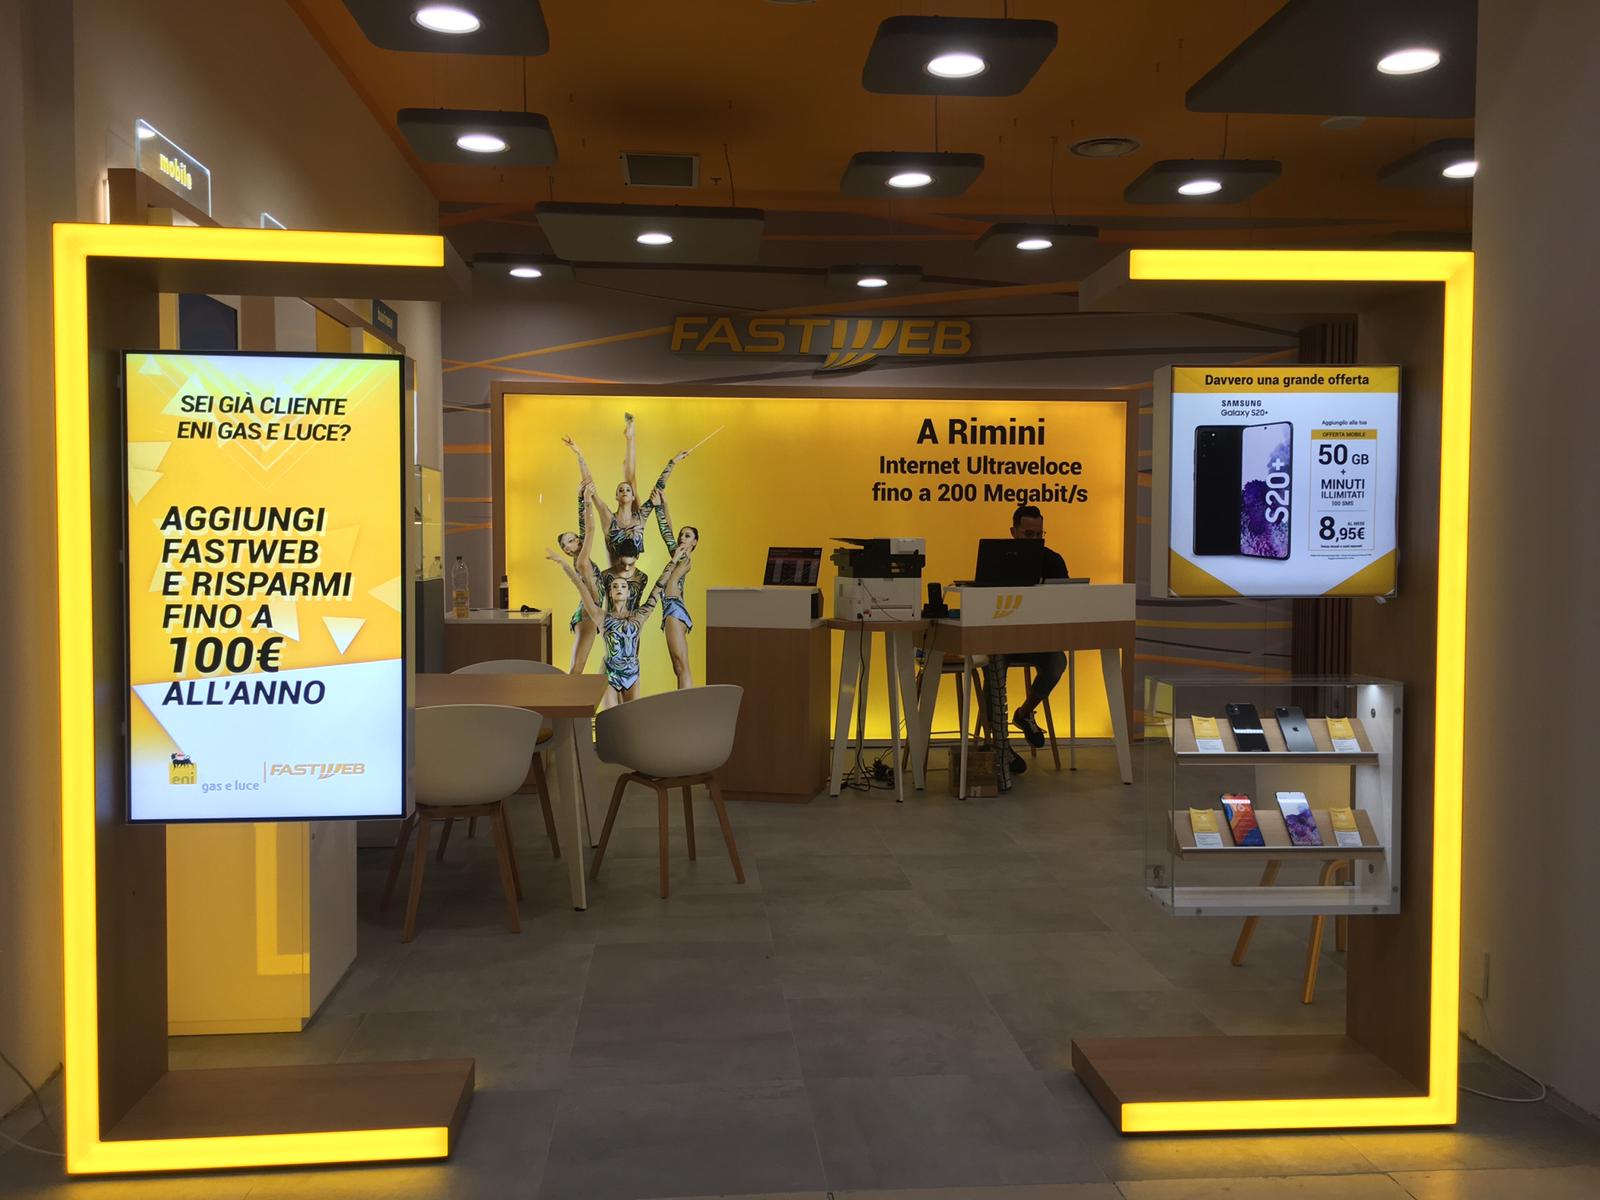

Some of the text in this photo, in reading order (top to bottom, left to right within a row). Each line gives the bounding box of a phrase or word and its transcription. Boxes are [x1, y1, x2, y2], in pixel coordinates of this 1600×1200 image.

[159, 153, 192, 190] mobile
[671, 316, 972, 369] FASTWEB
[1205, 374, 1370, 388] Davvero una grande offerta
[180, 391, 347, 415] SEI GIÀ CLIENTE
[1221, 409, 1268, 418] Galaxy S20+
[177, 421, 352, 441] ENI GAS E LUCE?
[916, 417, 1045, 445] A Rimini
[880, 456, 1082, 476] Internet Ultraveloce
[1318, 443, 1369, 466] 50 GB
[872, 482, 1088, 507] fino a 200 Megabit/s
[1265, 458, 1290, 523] S20+
[1321, 479, 1365, 490] MINUTI
[1321, 491, 1365, 499] ILLIMITATI
[160, 505, 325, 532] AGGIUNGI
[162, 538, 319, 564] FASTWEB
[162, 571, 352, 597] E RISPARMI
[162, 603, 273, 629] FINO A
[169, 636, 283, 674] 100€
[162, 680, 326, 706] ALL'ANNO
[172, 771, 195, 785] eni
[270, 763, 365, 780] FASTWEB
[202, 780, 260, 793] gas e luce
